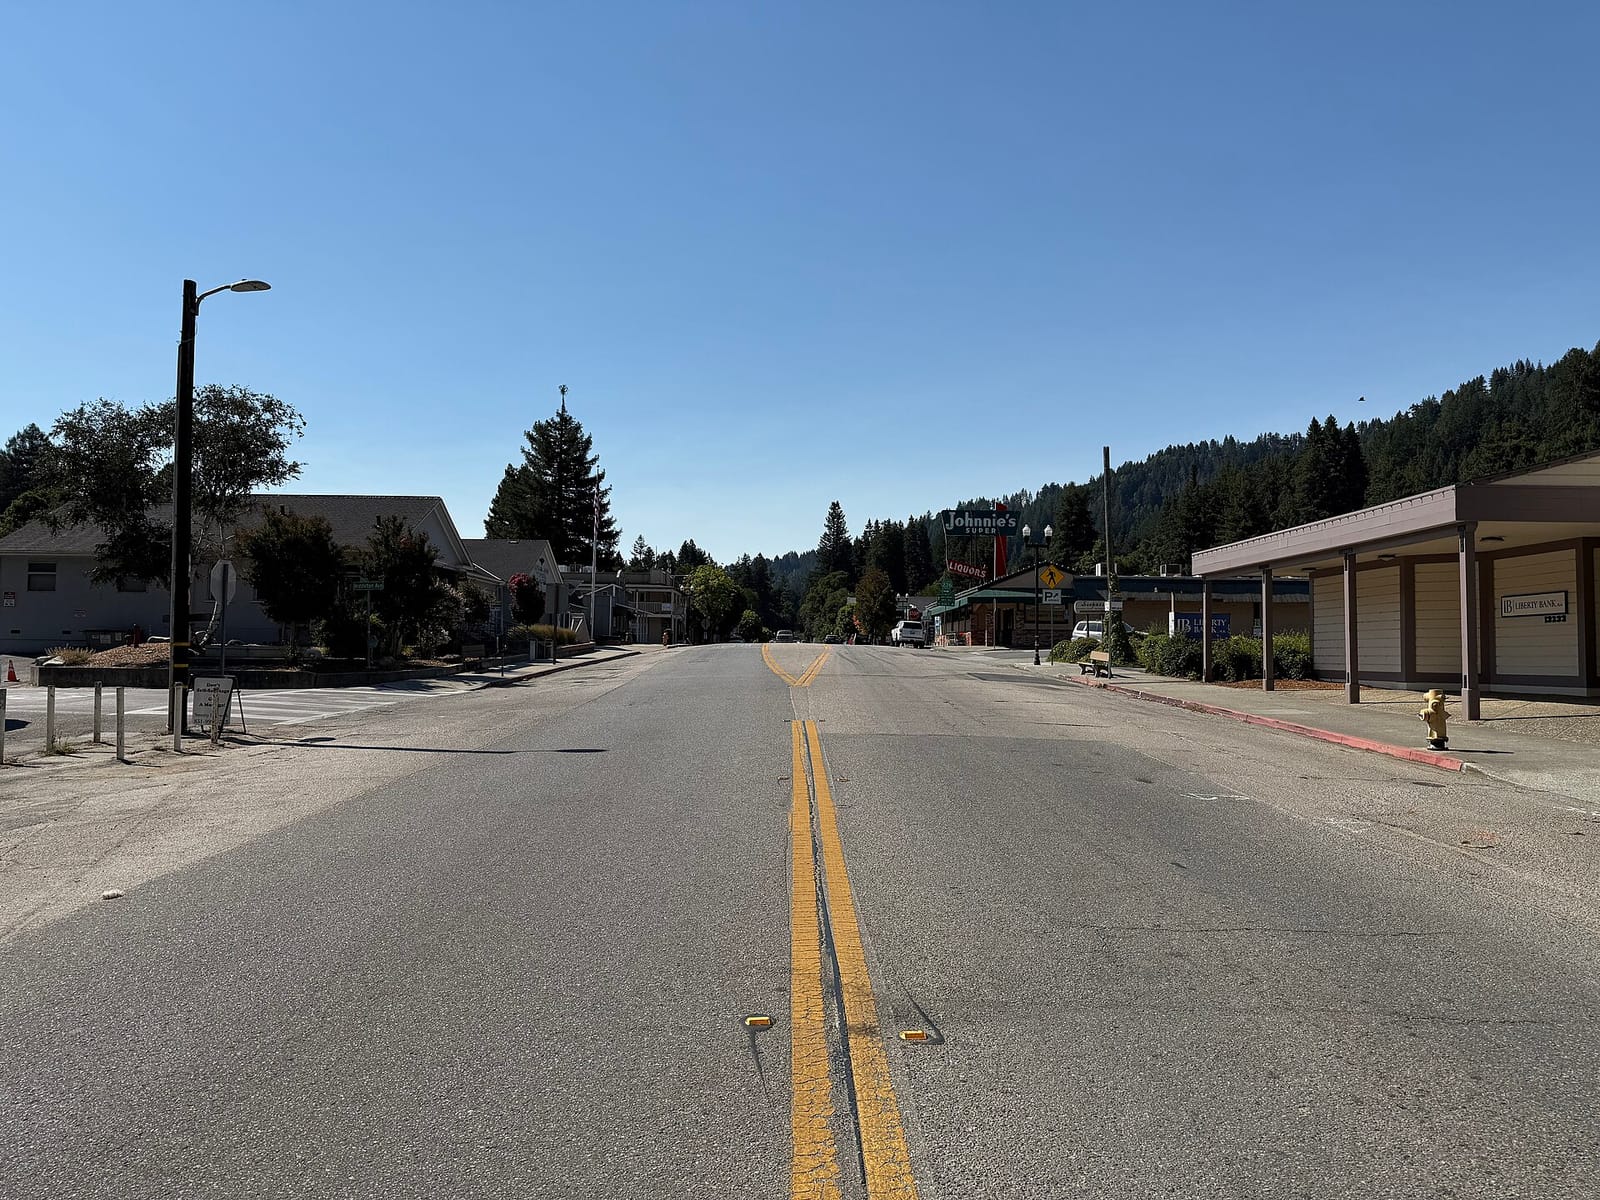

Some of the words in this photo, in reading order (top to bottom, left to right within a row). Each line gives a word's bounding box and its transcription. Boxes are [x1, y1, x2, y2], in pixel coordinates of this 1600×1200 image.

[945, 511, 1017, 530] Johnnie's
[949, 561, 987, 578] LIQUORS
[1515, 601, 1538, 610] LIBERTY
[1539, 600, 1556, 608] BANK
[1193, 618, 1226, 626] LIRTY
